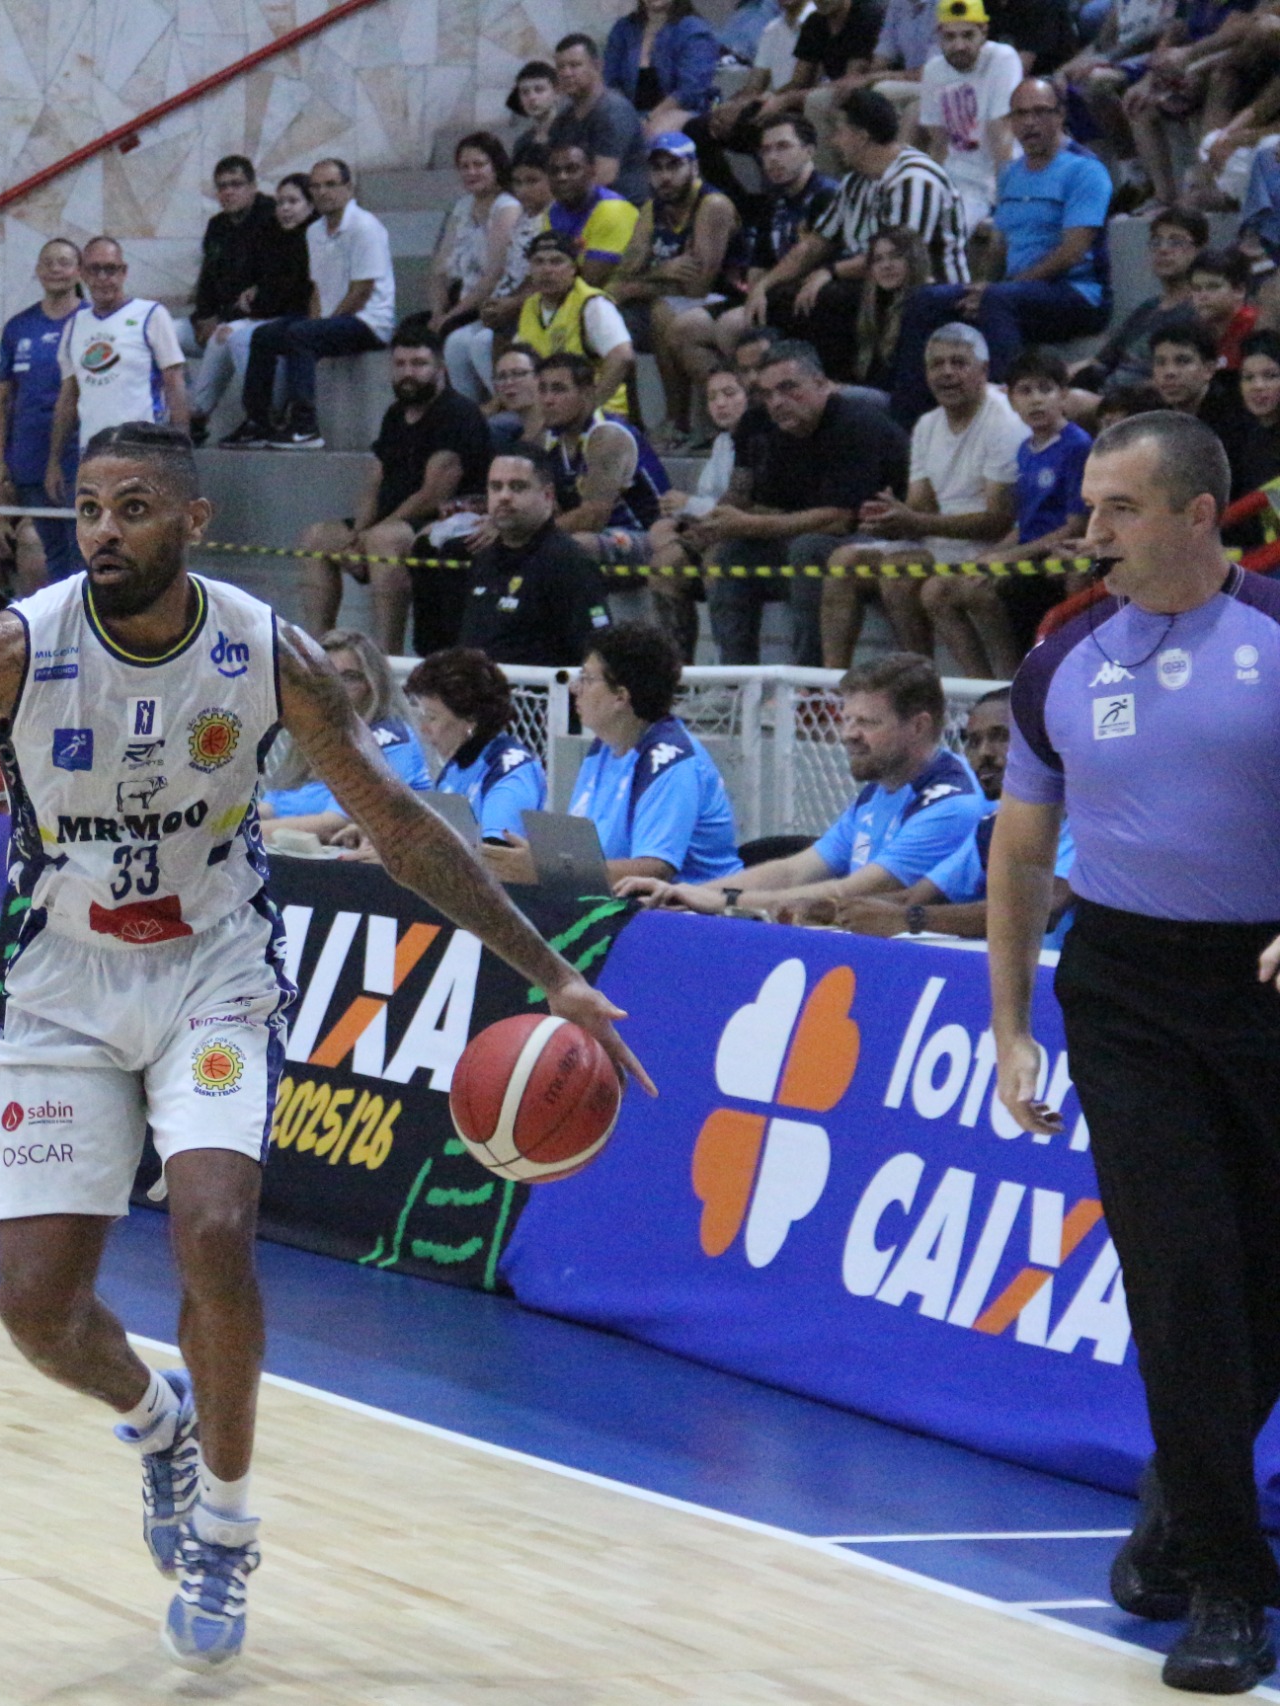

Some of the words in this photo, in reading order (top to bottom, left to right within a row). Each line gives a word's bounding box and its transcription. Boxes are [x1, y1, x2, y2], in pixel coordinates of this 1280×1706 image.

[110, 844, 161, 901] 33
[280, 904, 483, 1093] IXA
[27, 1100, 74, 1120] sabin
[270, 1076, 403, 1171] 2025/26
[3, 1143, 74, 1168] OSCAR
[842, 1152, 1132, 1366] CAIXA
